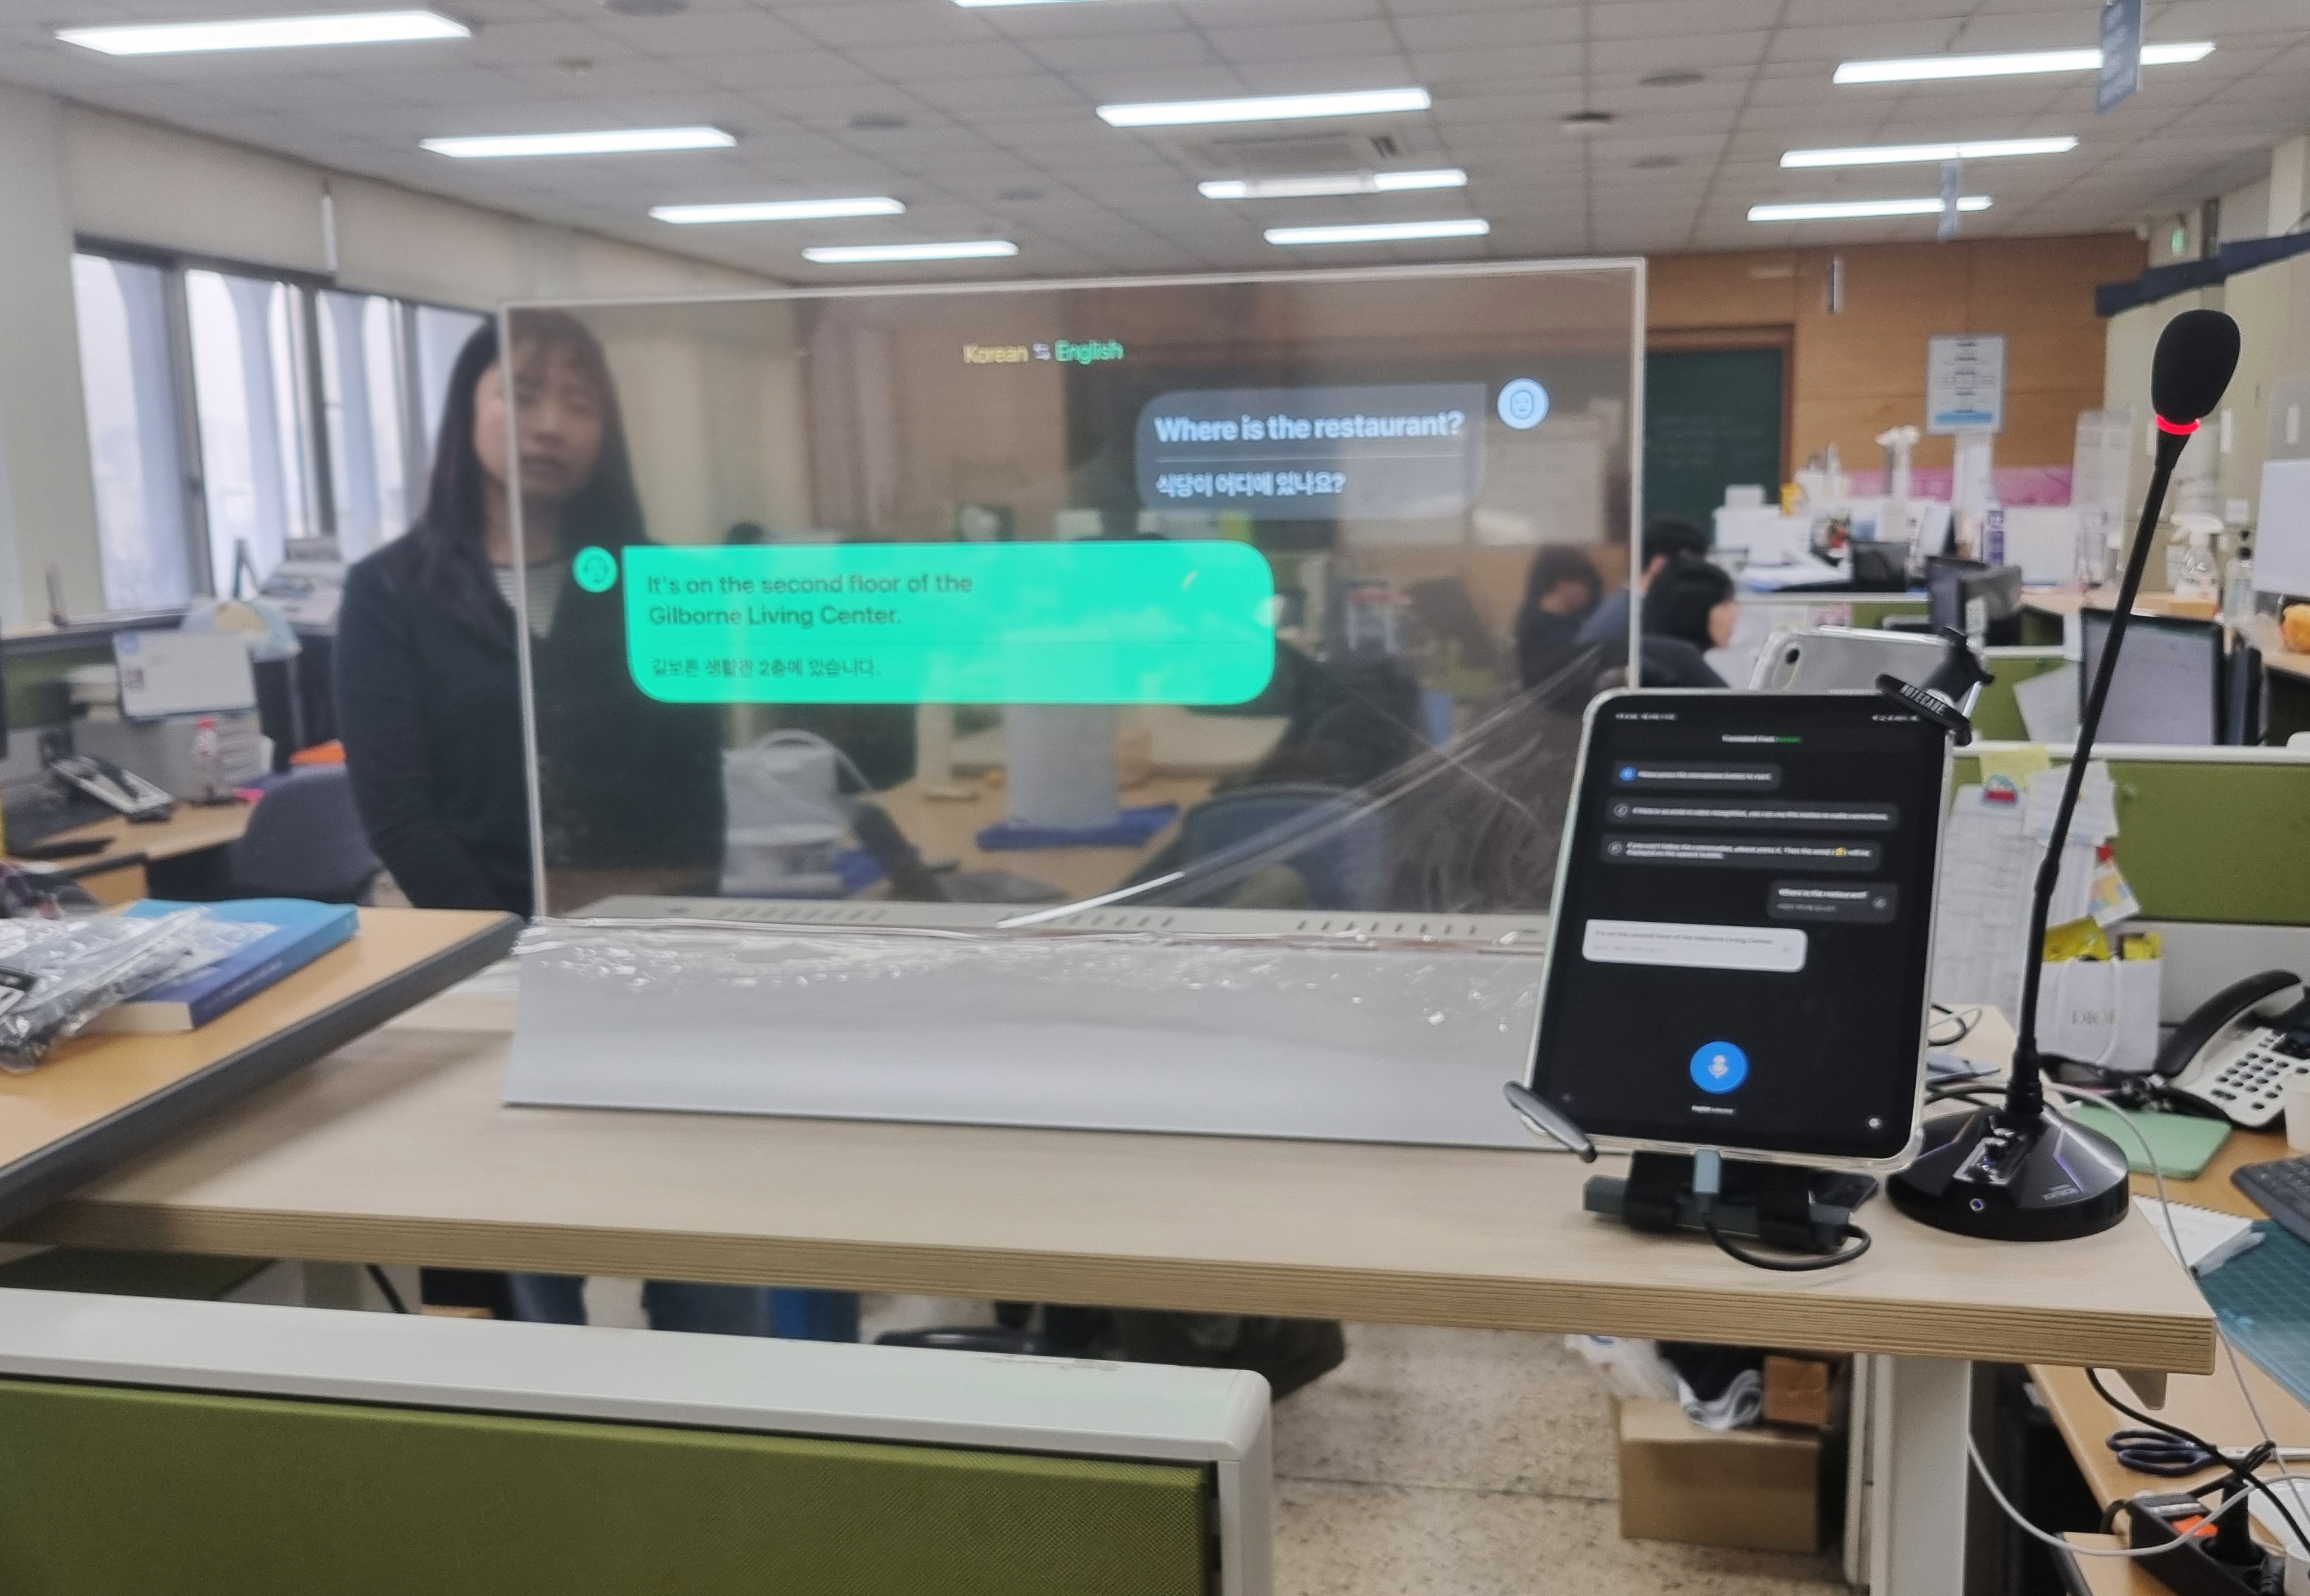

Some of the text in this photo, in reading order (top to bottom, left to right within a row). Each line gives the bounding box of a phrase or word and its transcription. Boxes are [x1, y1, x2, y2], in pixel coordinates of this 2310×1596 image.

[962, 339, 1124, 365] Korean English
[1154, 410, 1465, 442] Where is the restaurant?
[1156, 471, 1346, 498] 식당이 어디에 있나요?
[648, 574, 973, 594] It's on the second floor of the
[649, 604, 902, 629] Gilborne Living Center.
[759, 657, 804, 677] 2층에
[809, 657, 881, 677] 있습니다.
